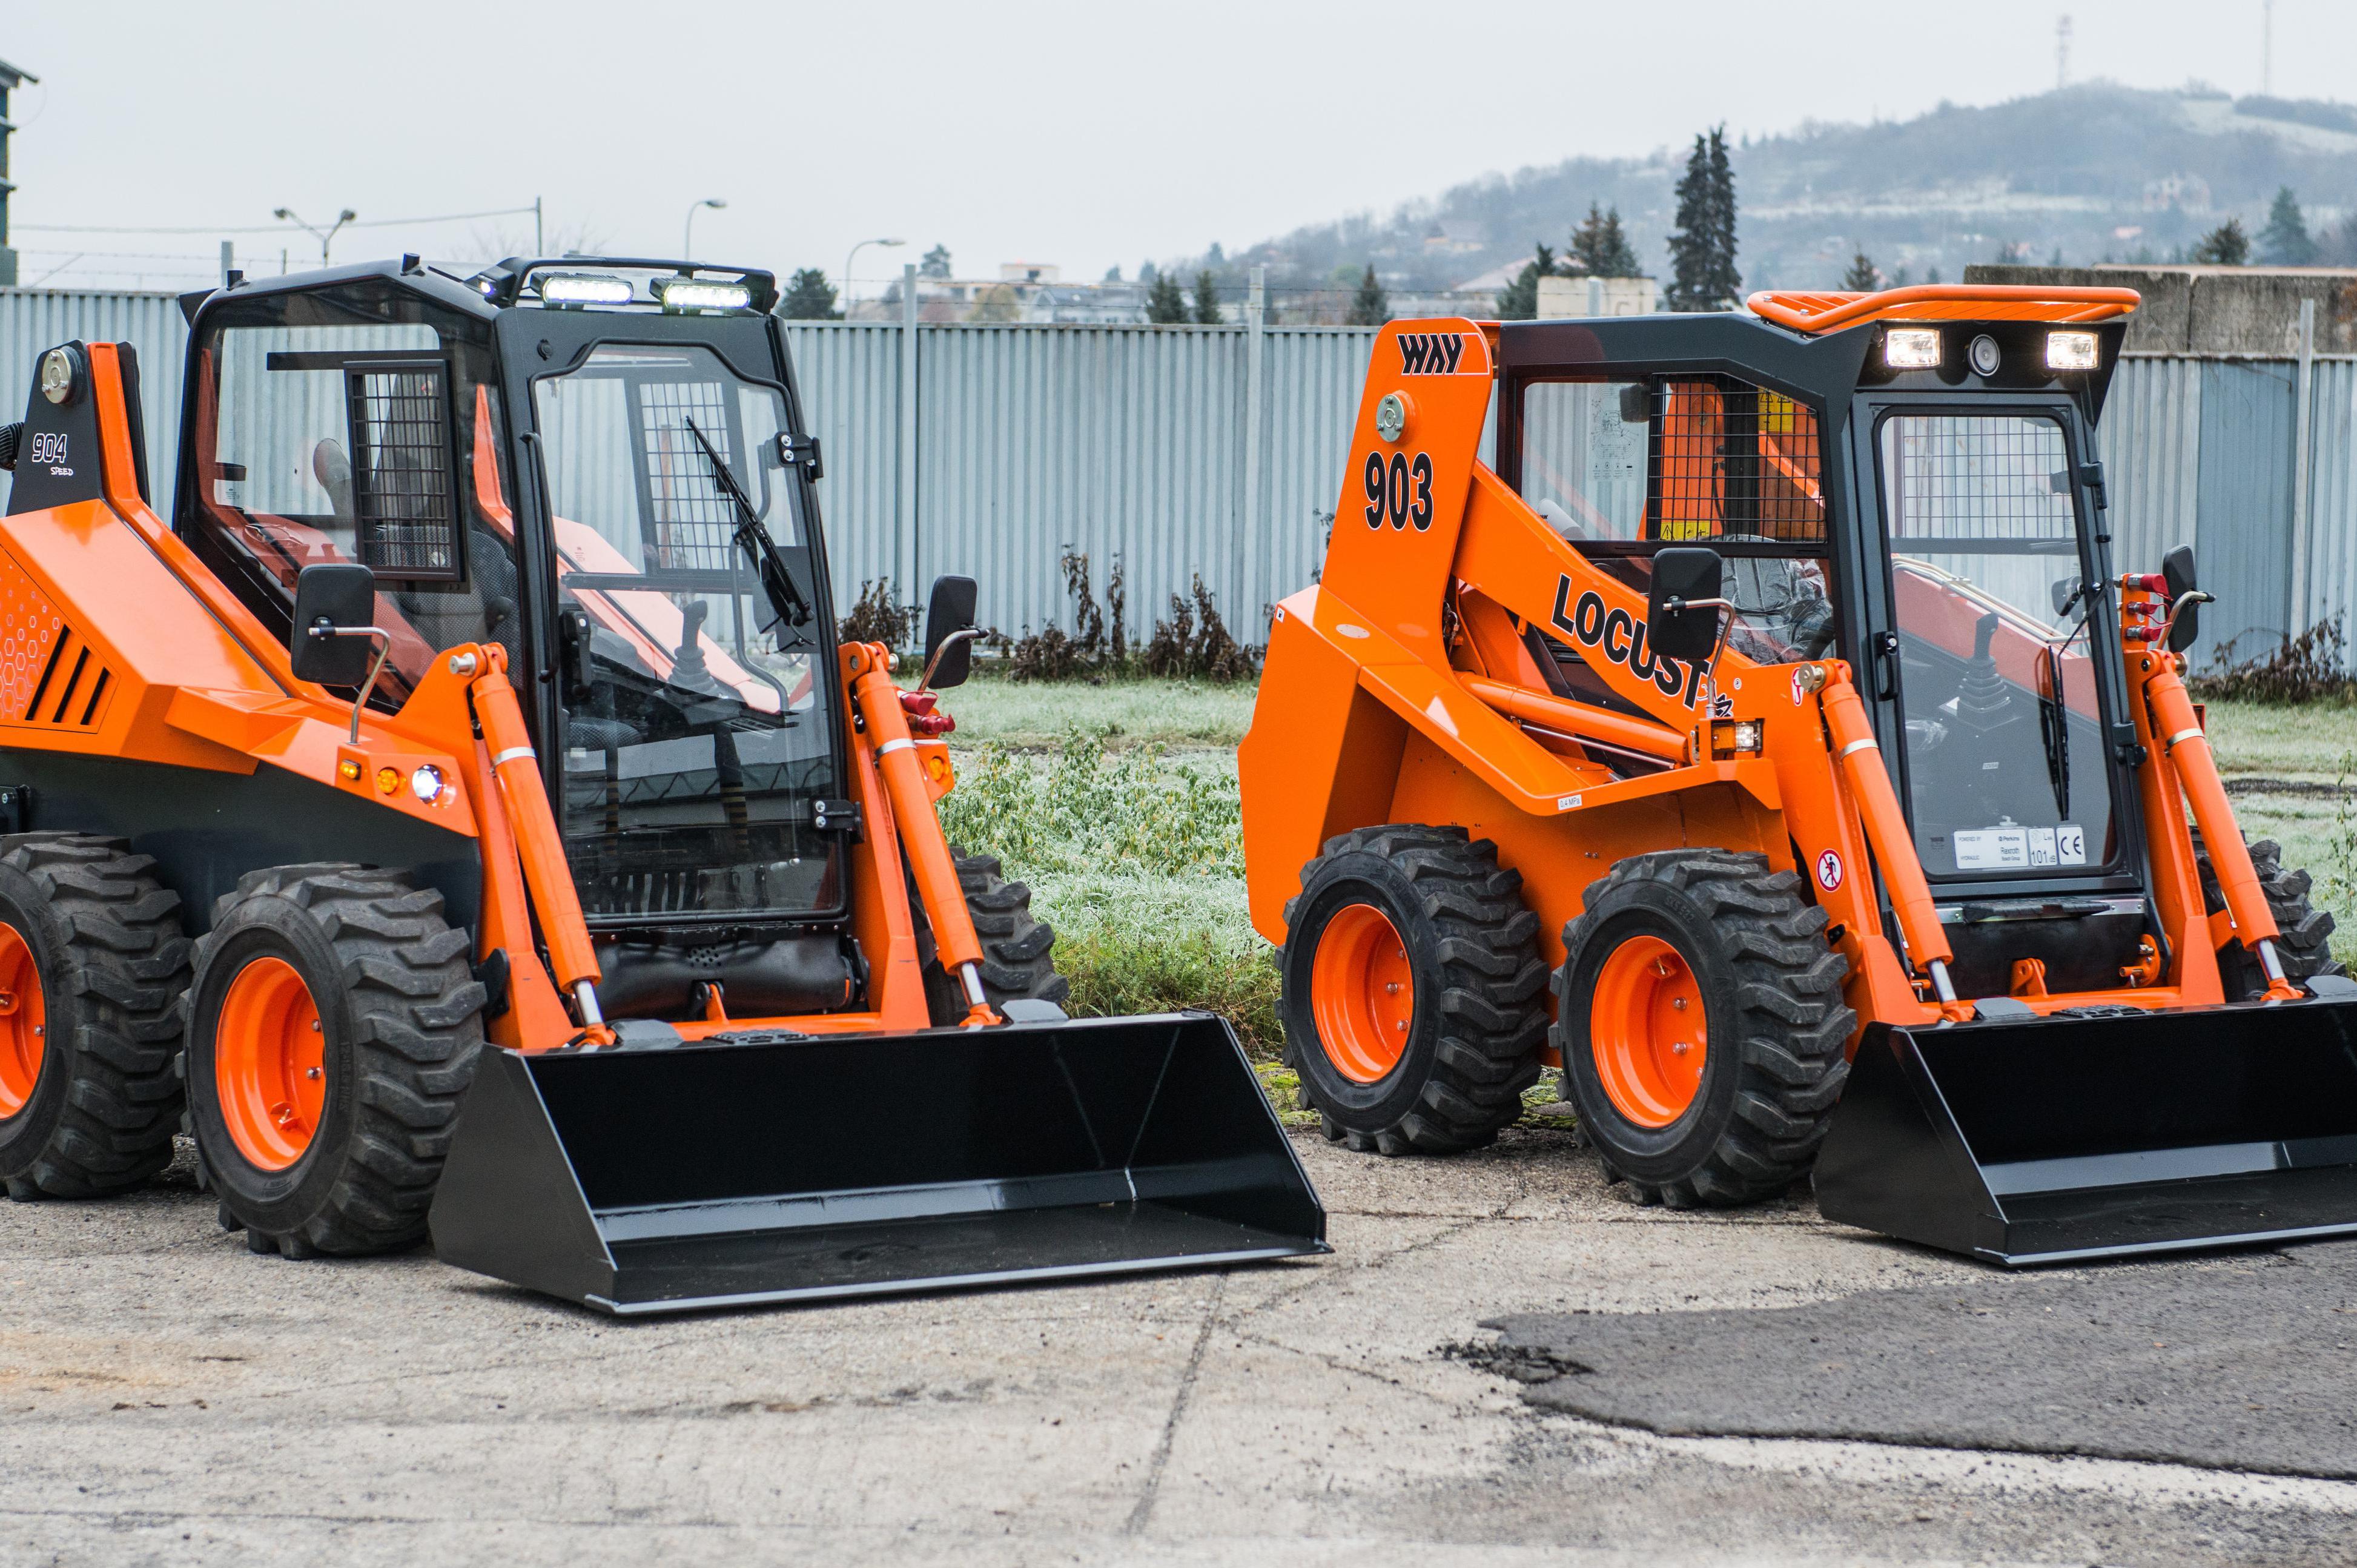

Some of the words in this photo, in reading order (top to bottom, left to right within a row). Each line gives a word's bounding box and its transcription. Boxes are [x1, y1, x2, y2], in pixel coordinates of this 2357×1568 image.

[1396, 332, 1464, 375] WAY
[32, 433, 67, 463] 904
[50, 467, 73, 476] SPEED
[1364, 451, 1434, 532] 903
[1569, 797, 1580, 806] MPa
[2060, 836, 2082, 856] CE
[2031, 850, 2048, 864] 101
